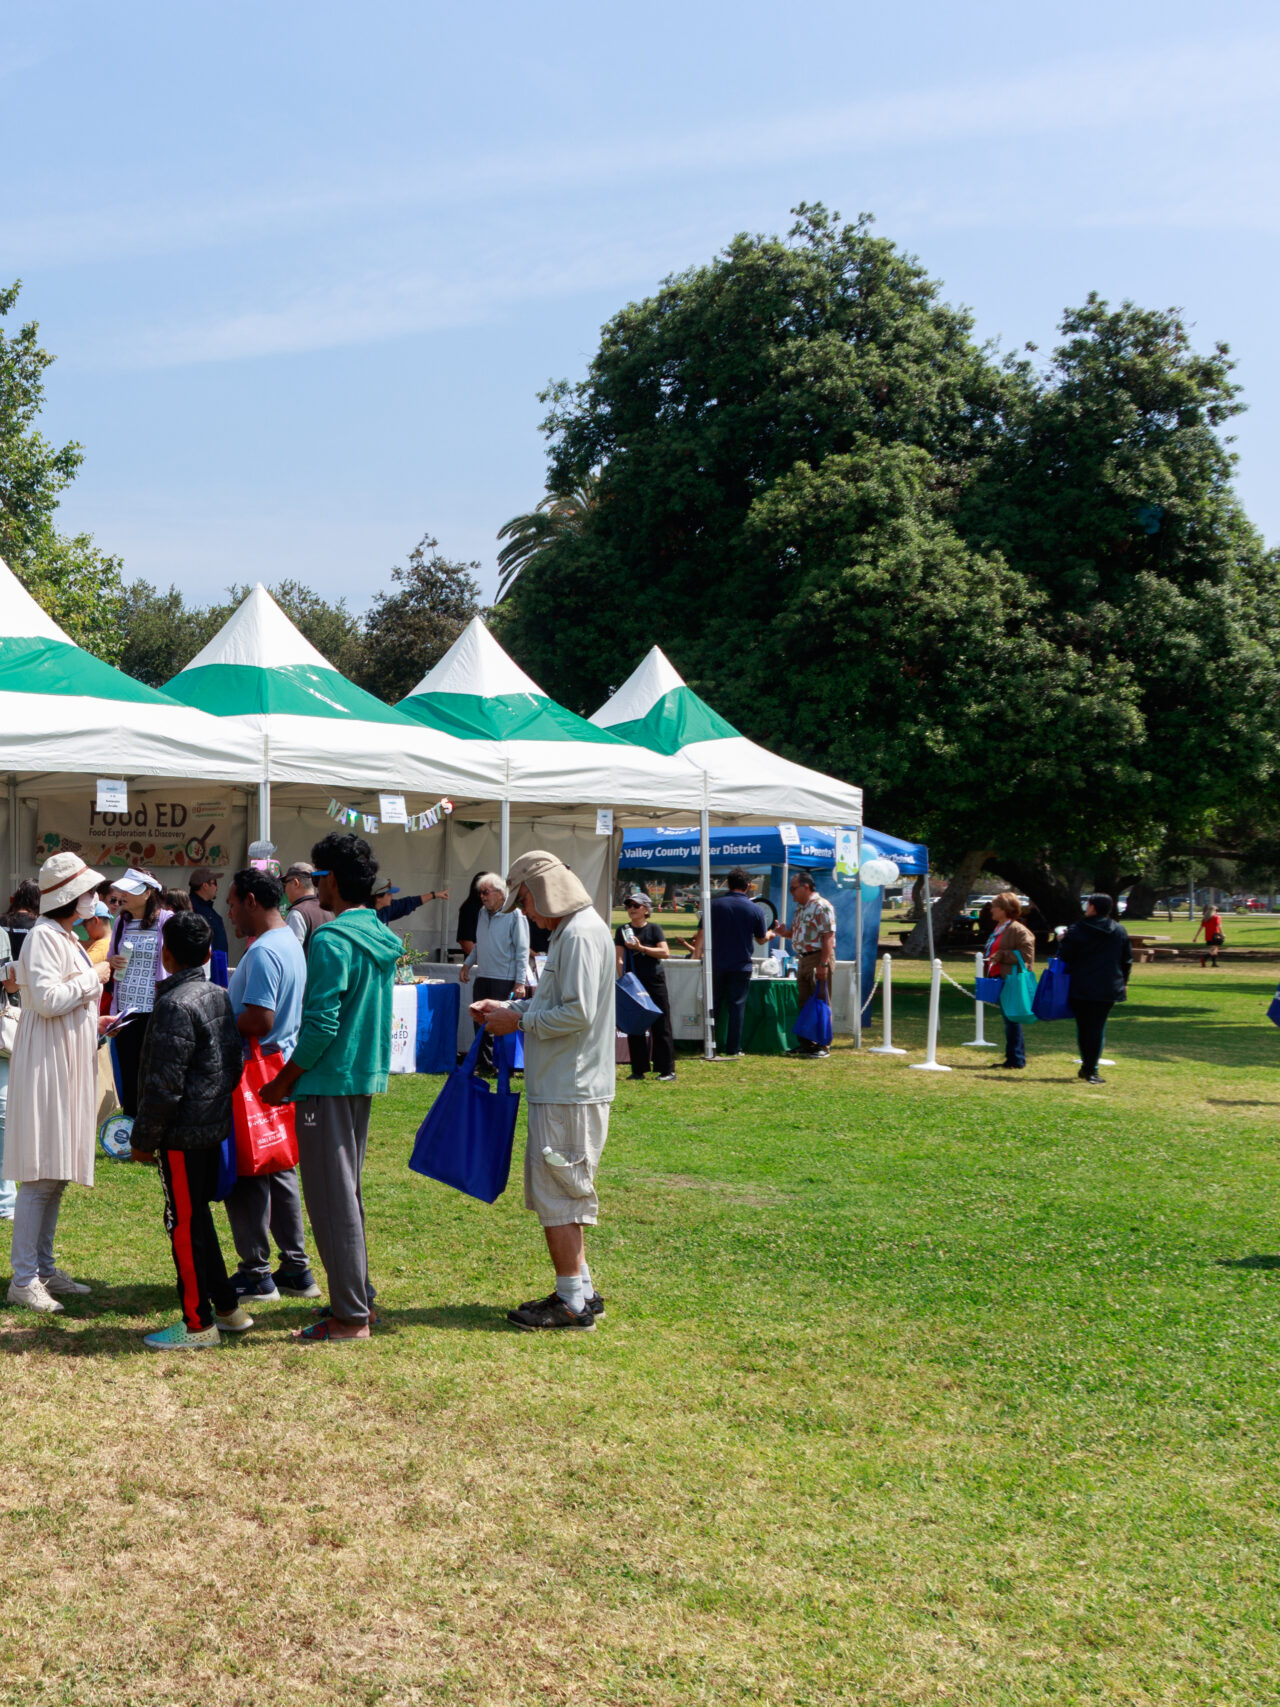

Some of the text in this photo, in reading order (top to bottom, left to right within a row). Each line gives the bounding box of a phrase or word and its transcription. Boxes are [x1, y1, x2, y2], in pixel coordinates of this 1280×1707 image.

[89, 800, 187, 828] Food ED
[326, 797, 453, 834] NATVE PLANTS
[89, 828, 186, 840] Food Exploration & Discovery
[624, 848, 654, 859] Valley
[655, 847, 689, 858] County
[691, 845, 721, 855] Wter
[723, 843, 761, 855] District
[801, 844, 809, 854] La
